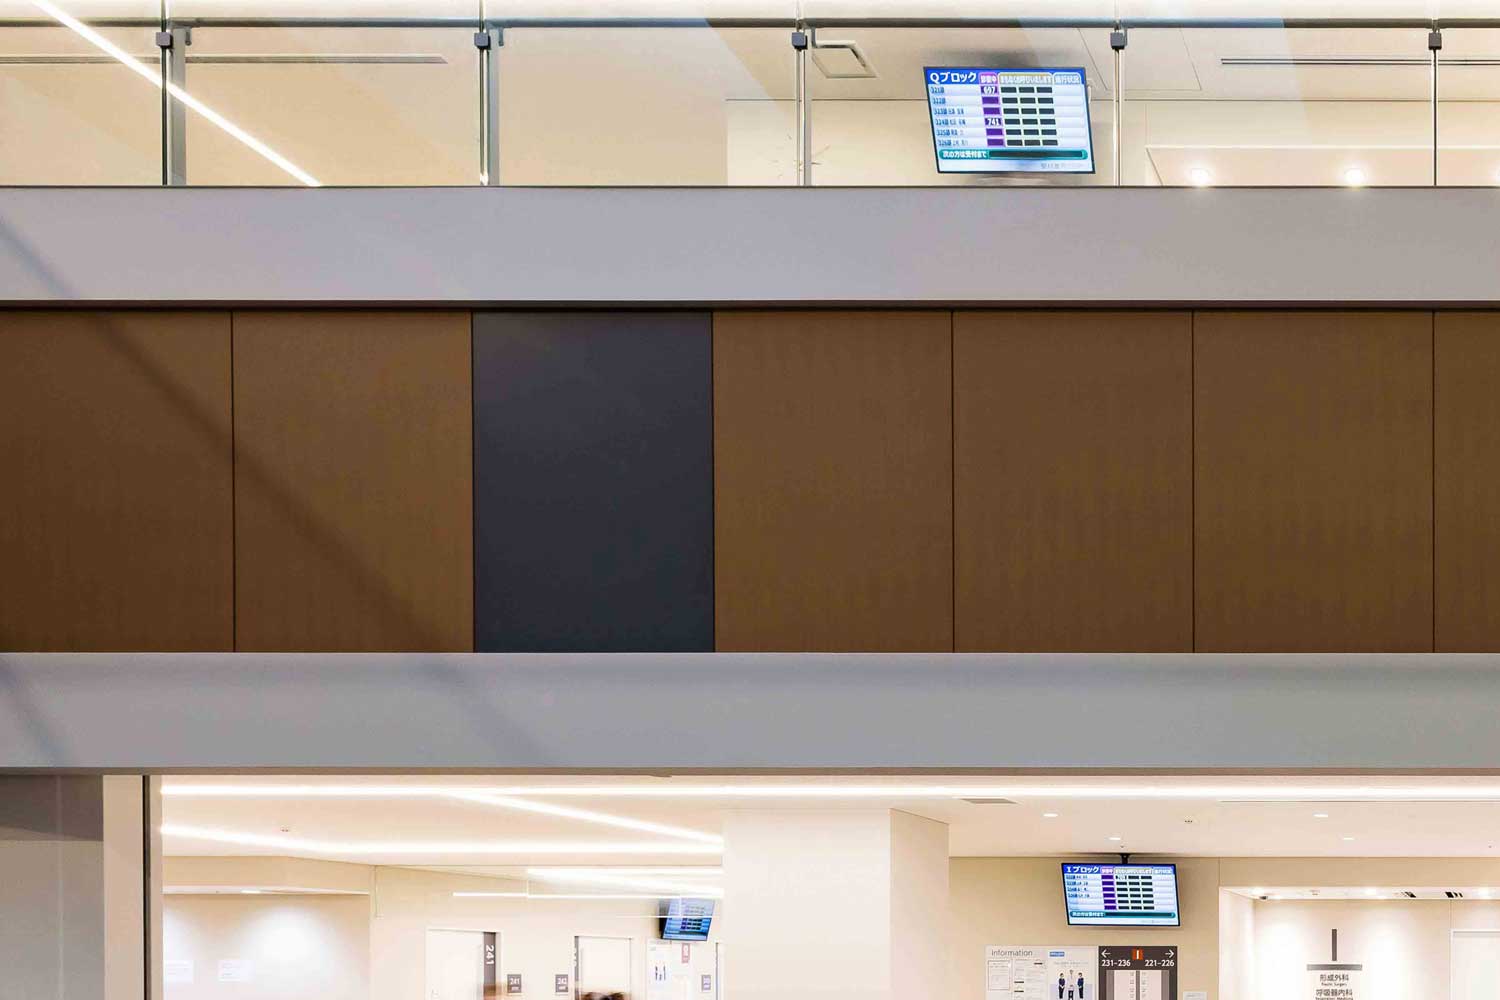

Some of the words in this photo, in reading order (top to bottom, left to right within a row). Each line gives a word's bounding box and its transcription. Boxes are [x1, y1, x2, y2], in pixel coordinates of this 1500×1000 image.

[930, 72, 977, 85] Qブロック
[485, 945, 495, 965] 241
